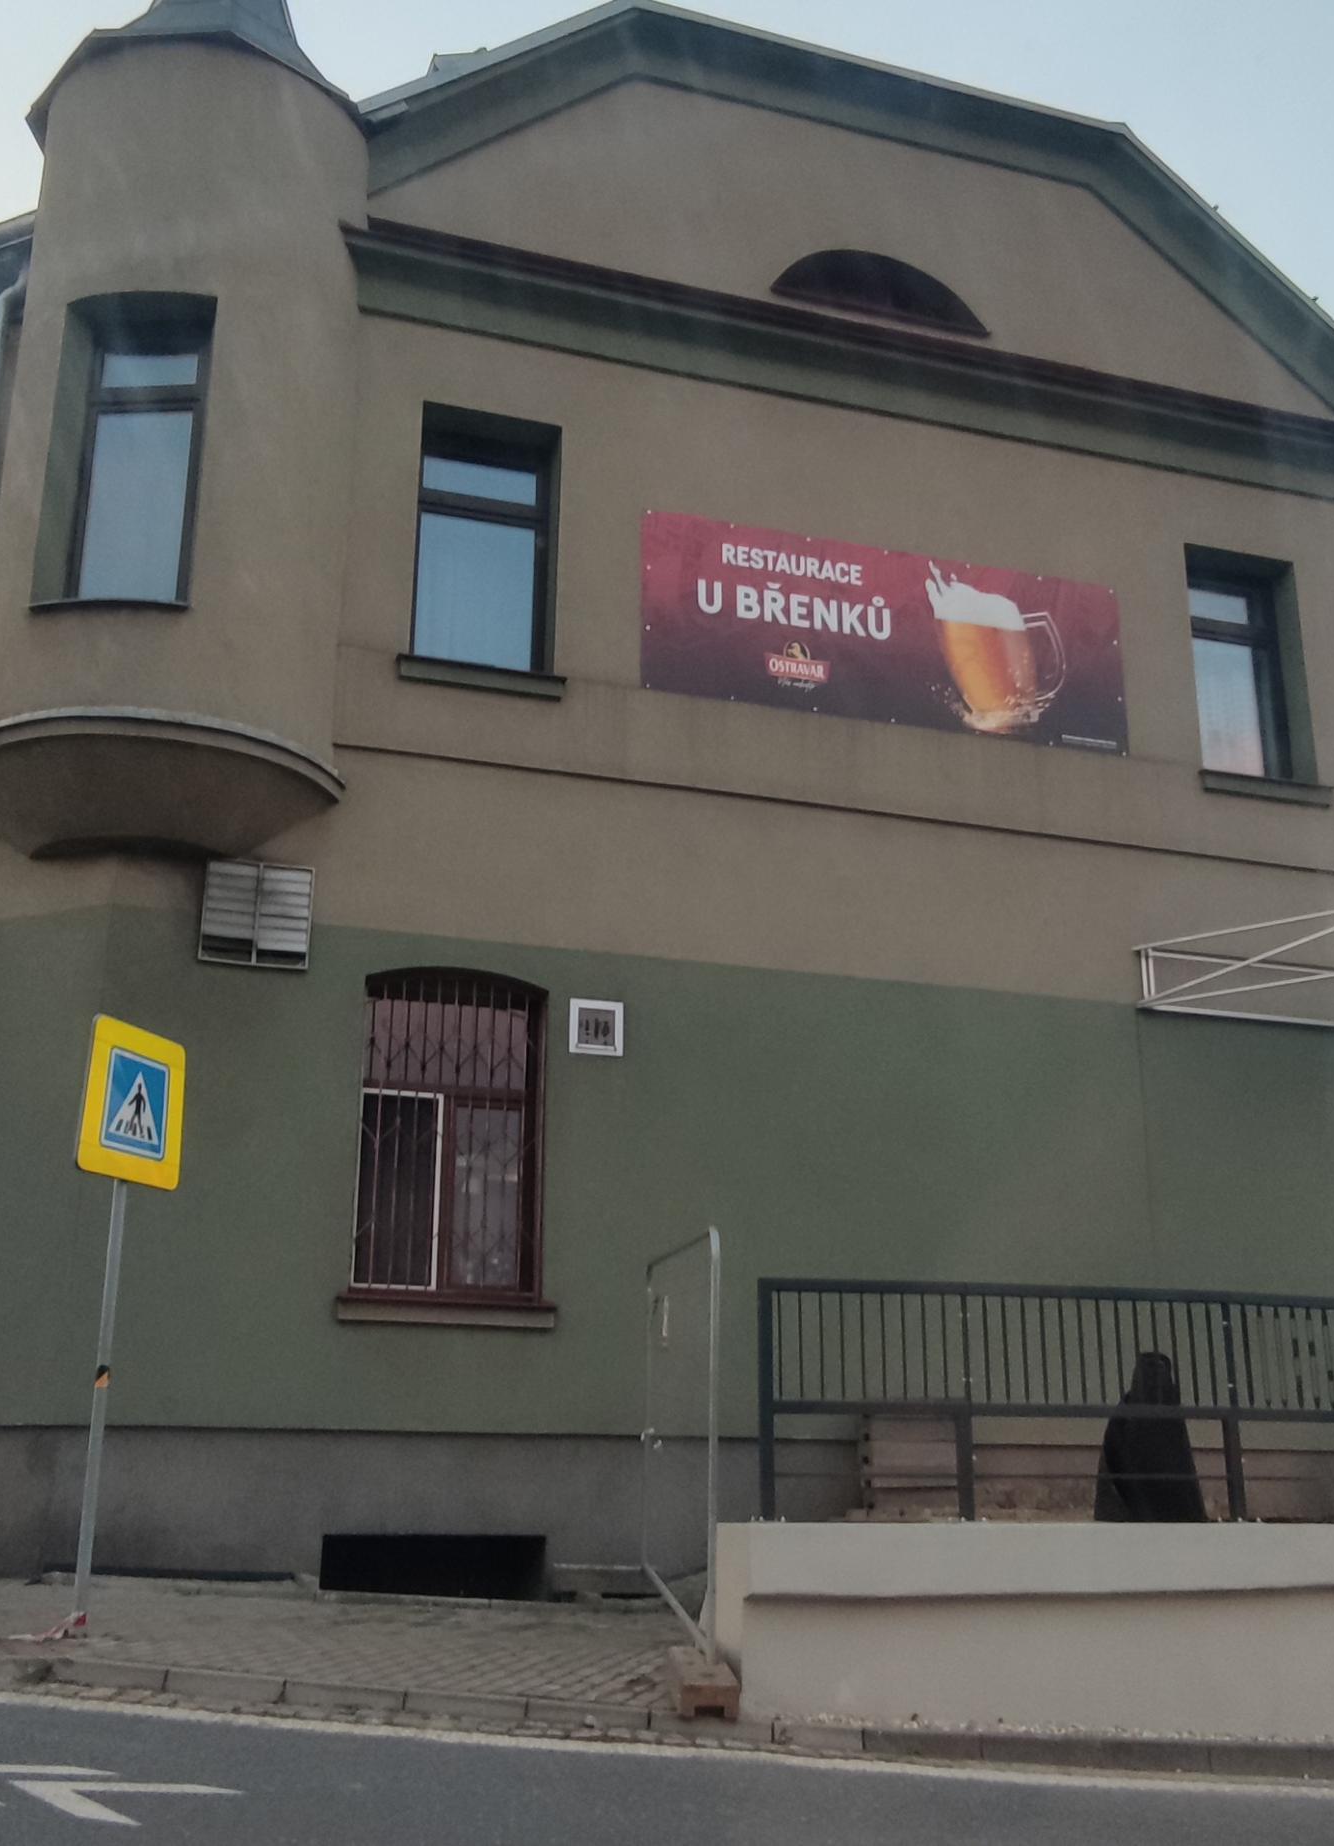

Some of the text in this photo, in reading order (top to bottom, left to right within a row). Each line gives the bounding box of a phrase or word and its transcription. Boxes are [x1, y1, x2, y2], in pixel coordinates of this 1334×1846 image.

[721, 542, 863, 587] RESTAURACE
[697, 578, 893, 641] U BŘENKŮ
[768, 657, 826, 680] OSTRAVAR
